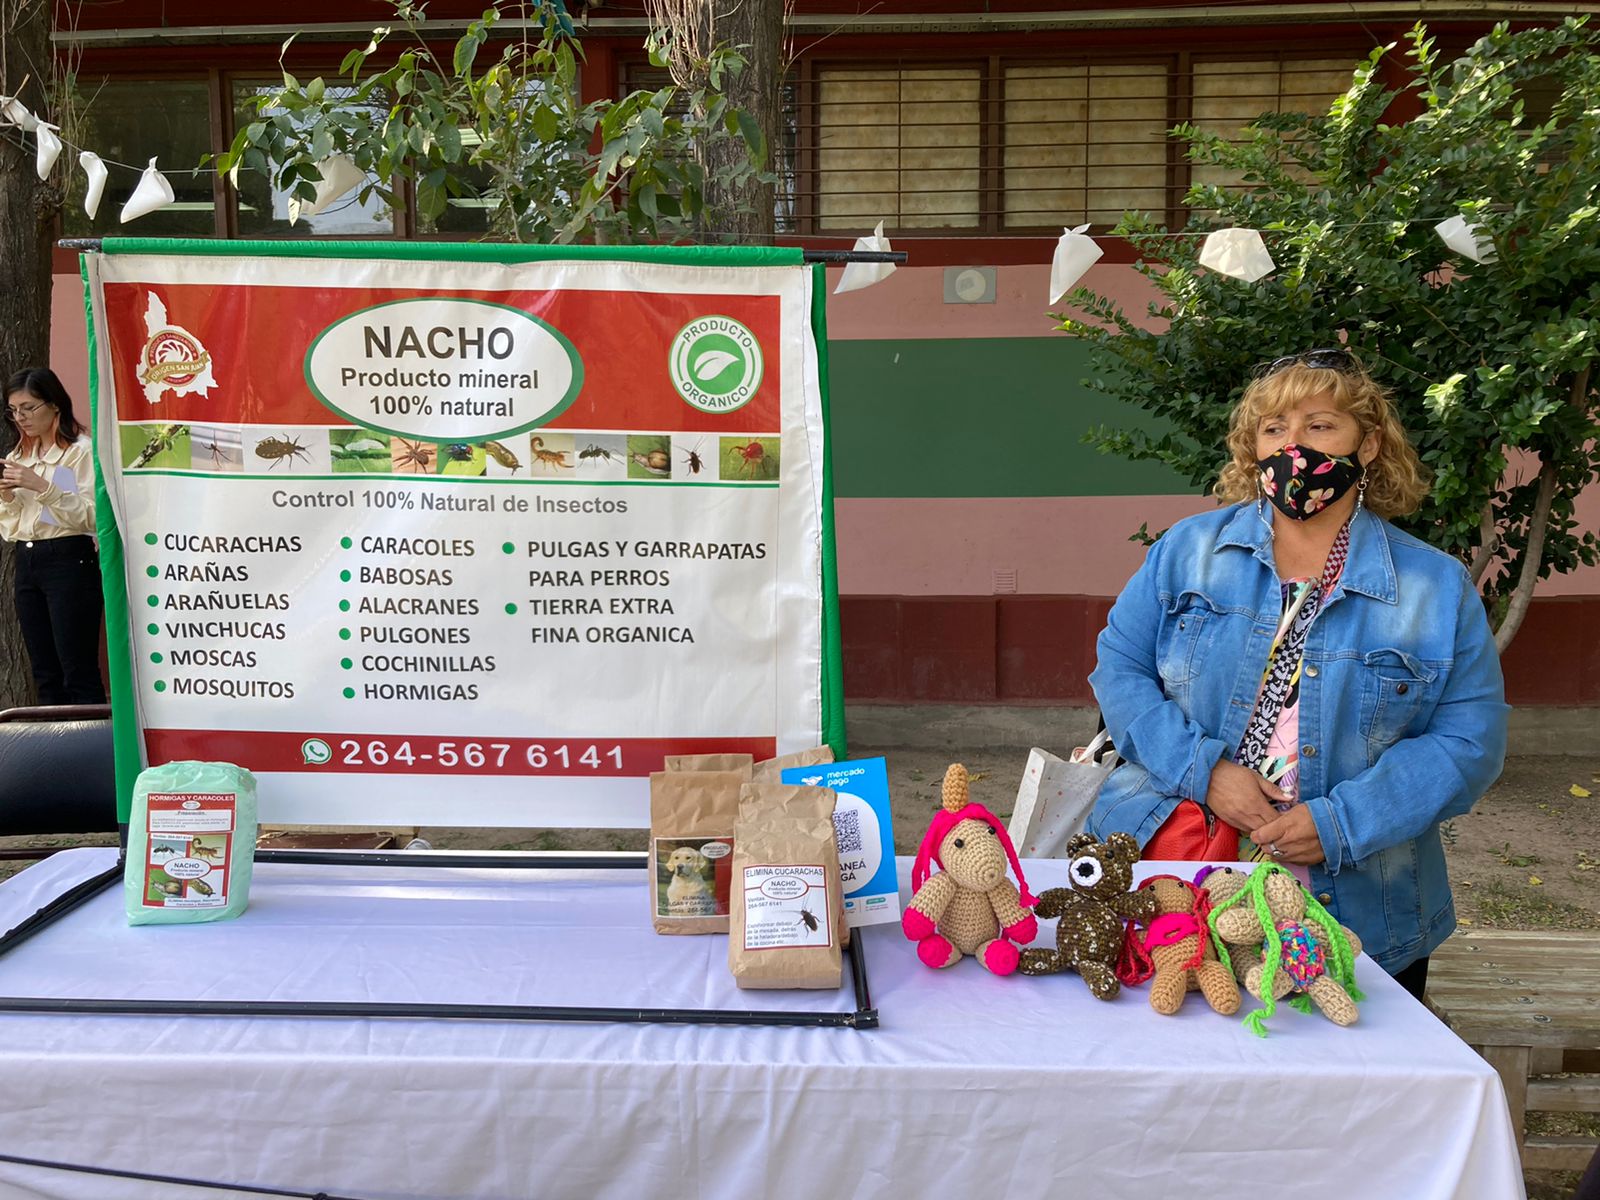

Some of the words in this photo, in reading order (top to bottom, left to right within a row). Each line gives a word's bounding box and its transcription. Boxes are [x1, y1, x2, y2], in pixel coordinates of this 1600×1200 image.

[364, 326, 515, 360] NACHO
[683, 319, 752, 348] PRODUCTO
[151, 364, 175, 380] ORIGEN
[190, 362, 204, 372] JUAN
[341, 368, 451, 388] Producto
[459, 369, 539, 390] mineral
[682, 381, 748, 408] ORGANICO
[370, 396, 433, 416] 100%
[440, 398, 514, 418] natural
[272, 490, 354, 508] Control
[362, 490, 415, 510] 100%
[420, 492, 496, 513] Natural
[503, 494, 529, 513] de
[536, 495, 629, 514] Insectos
[164, 533, 302, 553] CUCARACHAS
[360, 536, 476, 557] CARACOLES
[528, 540, 610, 558] PULGAS
[615, 540, 630, 558] Y
[633, 540, 767, 560] GARRAPATAS
[164, 561, 249, 583] ARAÑAS
[359, 566, 454, 586] BABOSAS
[529, 570, 584, 588] PARA
[590, 569, 670, 587] PERROS
[164, 590, 290, 611] ARAÑUELAS
[358, 597, 480, 616] ALACRANES
[529, 598, 604, 615] TIERRA
[609, 598, 675, 615] EXTRA
[165, 621, 286, 640] VINCHUCAS
[360, 626, 471, 644] PULGONES
[532, 627, 580, 644] FINA
[585, 626, 695, 644] ORGANICA
[170, 650, 257, 668] MOSCAS
[361, 655, 497, 673] COCHINILLAS
[172, 677, 295, 699] MOSQUITOS
[364, 683, 479, 701] HORMIGAS
[340, 740, 511, 767] 264-567
[526, 744, 623, 769] 6141
[827, 768, 865, 779] mercado
[828, 777, 849, 788] pago
[746, 868, 773, 877] ELIMINA
[774, 868, 823, 876] CUCARACHAS
[839, 858, 867, 871] ANEÁ
[840, 870, 857, 881] GÁ
